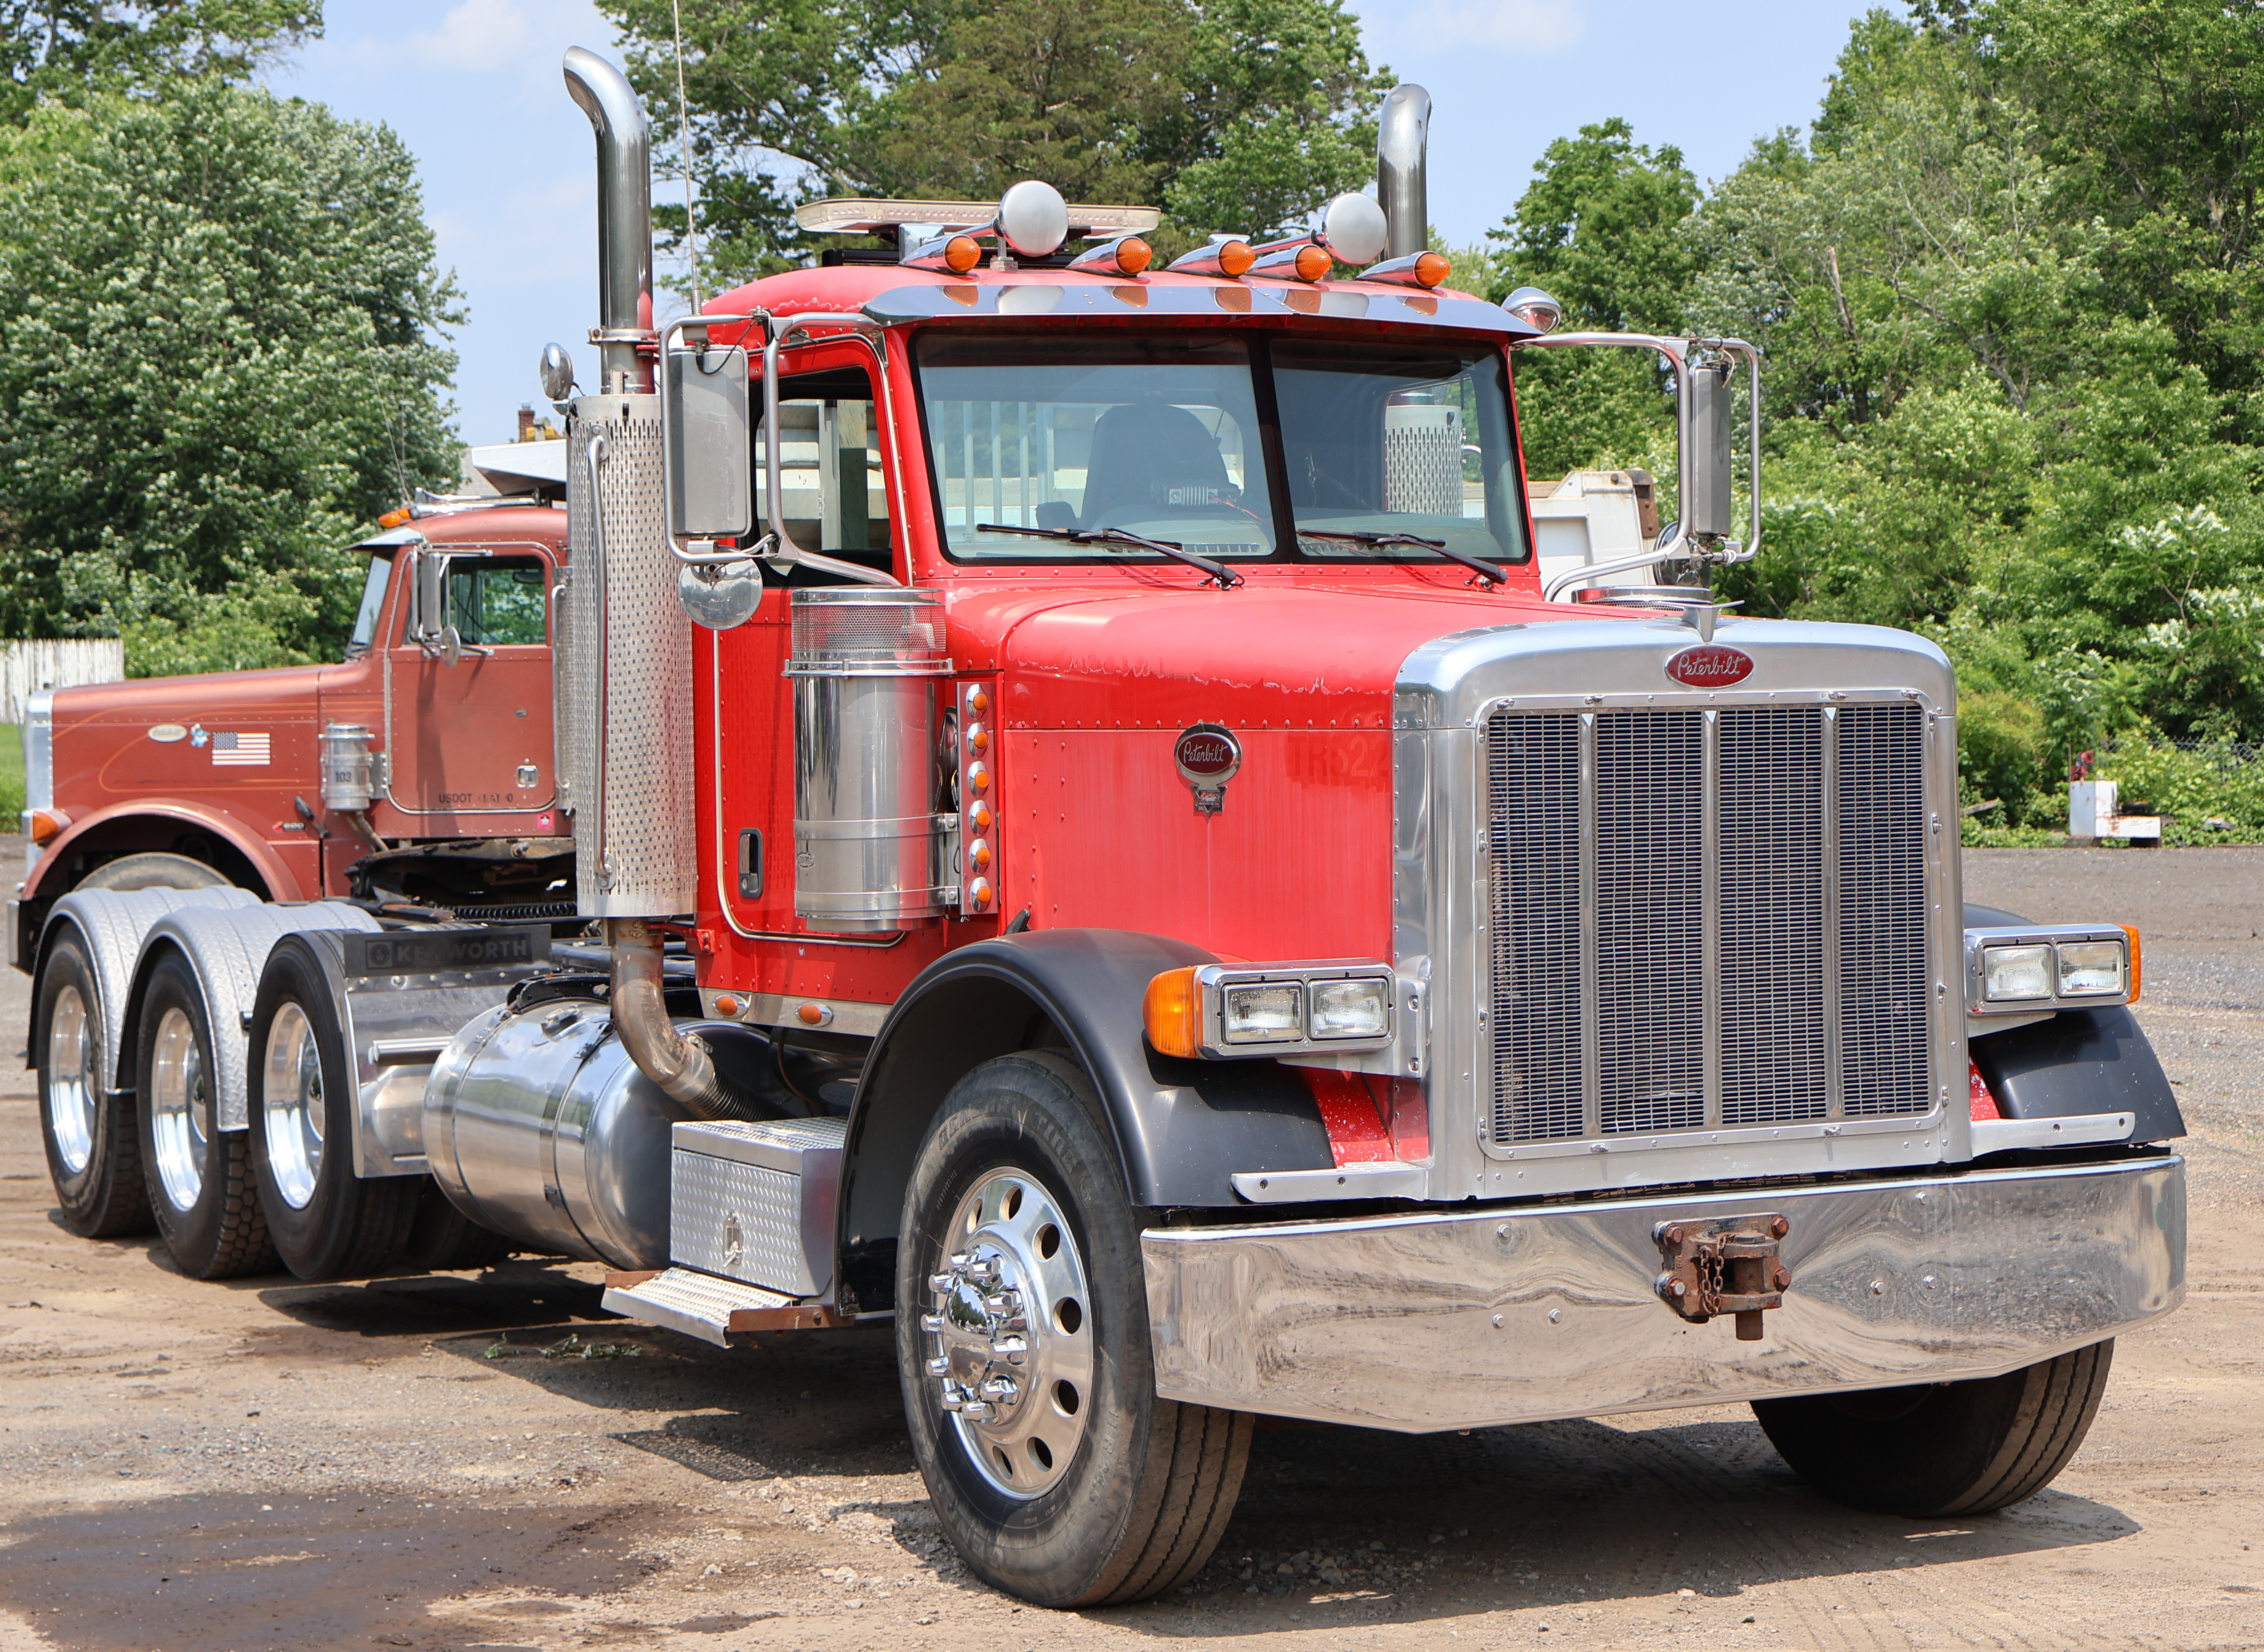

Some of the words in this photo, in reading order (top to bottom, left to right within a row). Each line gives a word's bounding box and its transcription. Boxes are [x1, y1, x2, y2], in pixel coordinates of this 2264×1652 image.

[1677, 654, 1746, 678] Peterbilt
[1183, 741, 1228, 764] Peterbilt
[1288, 735, 1389, 777] TR522
[336, 772, 351, 783] 103
[439, 793, 472, 803] USDOT
